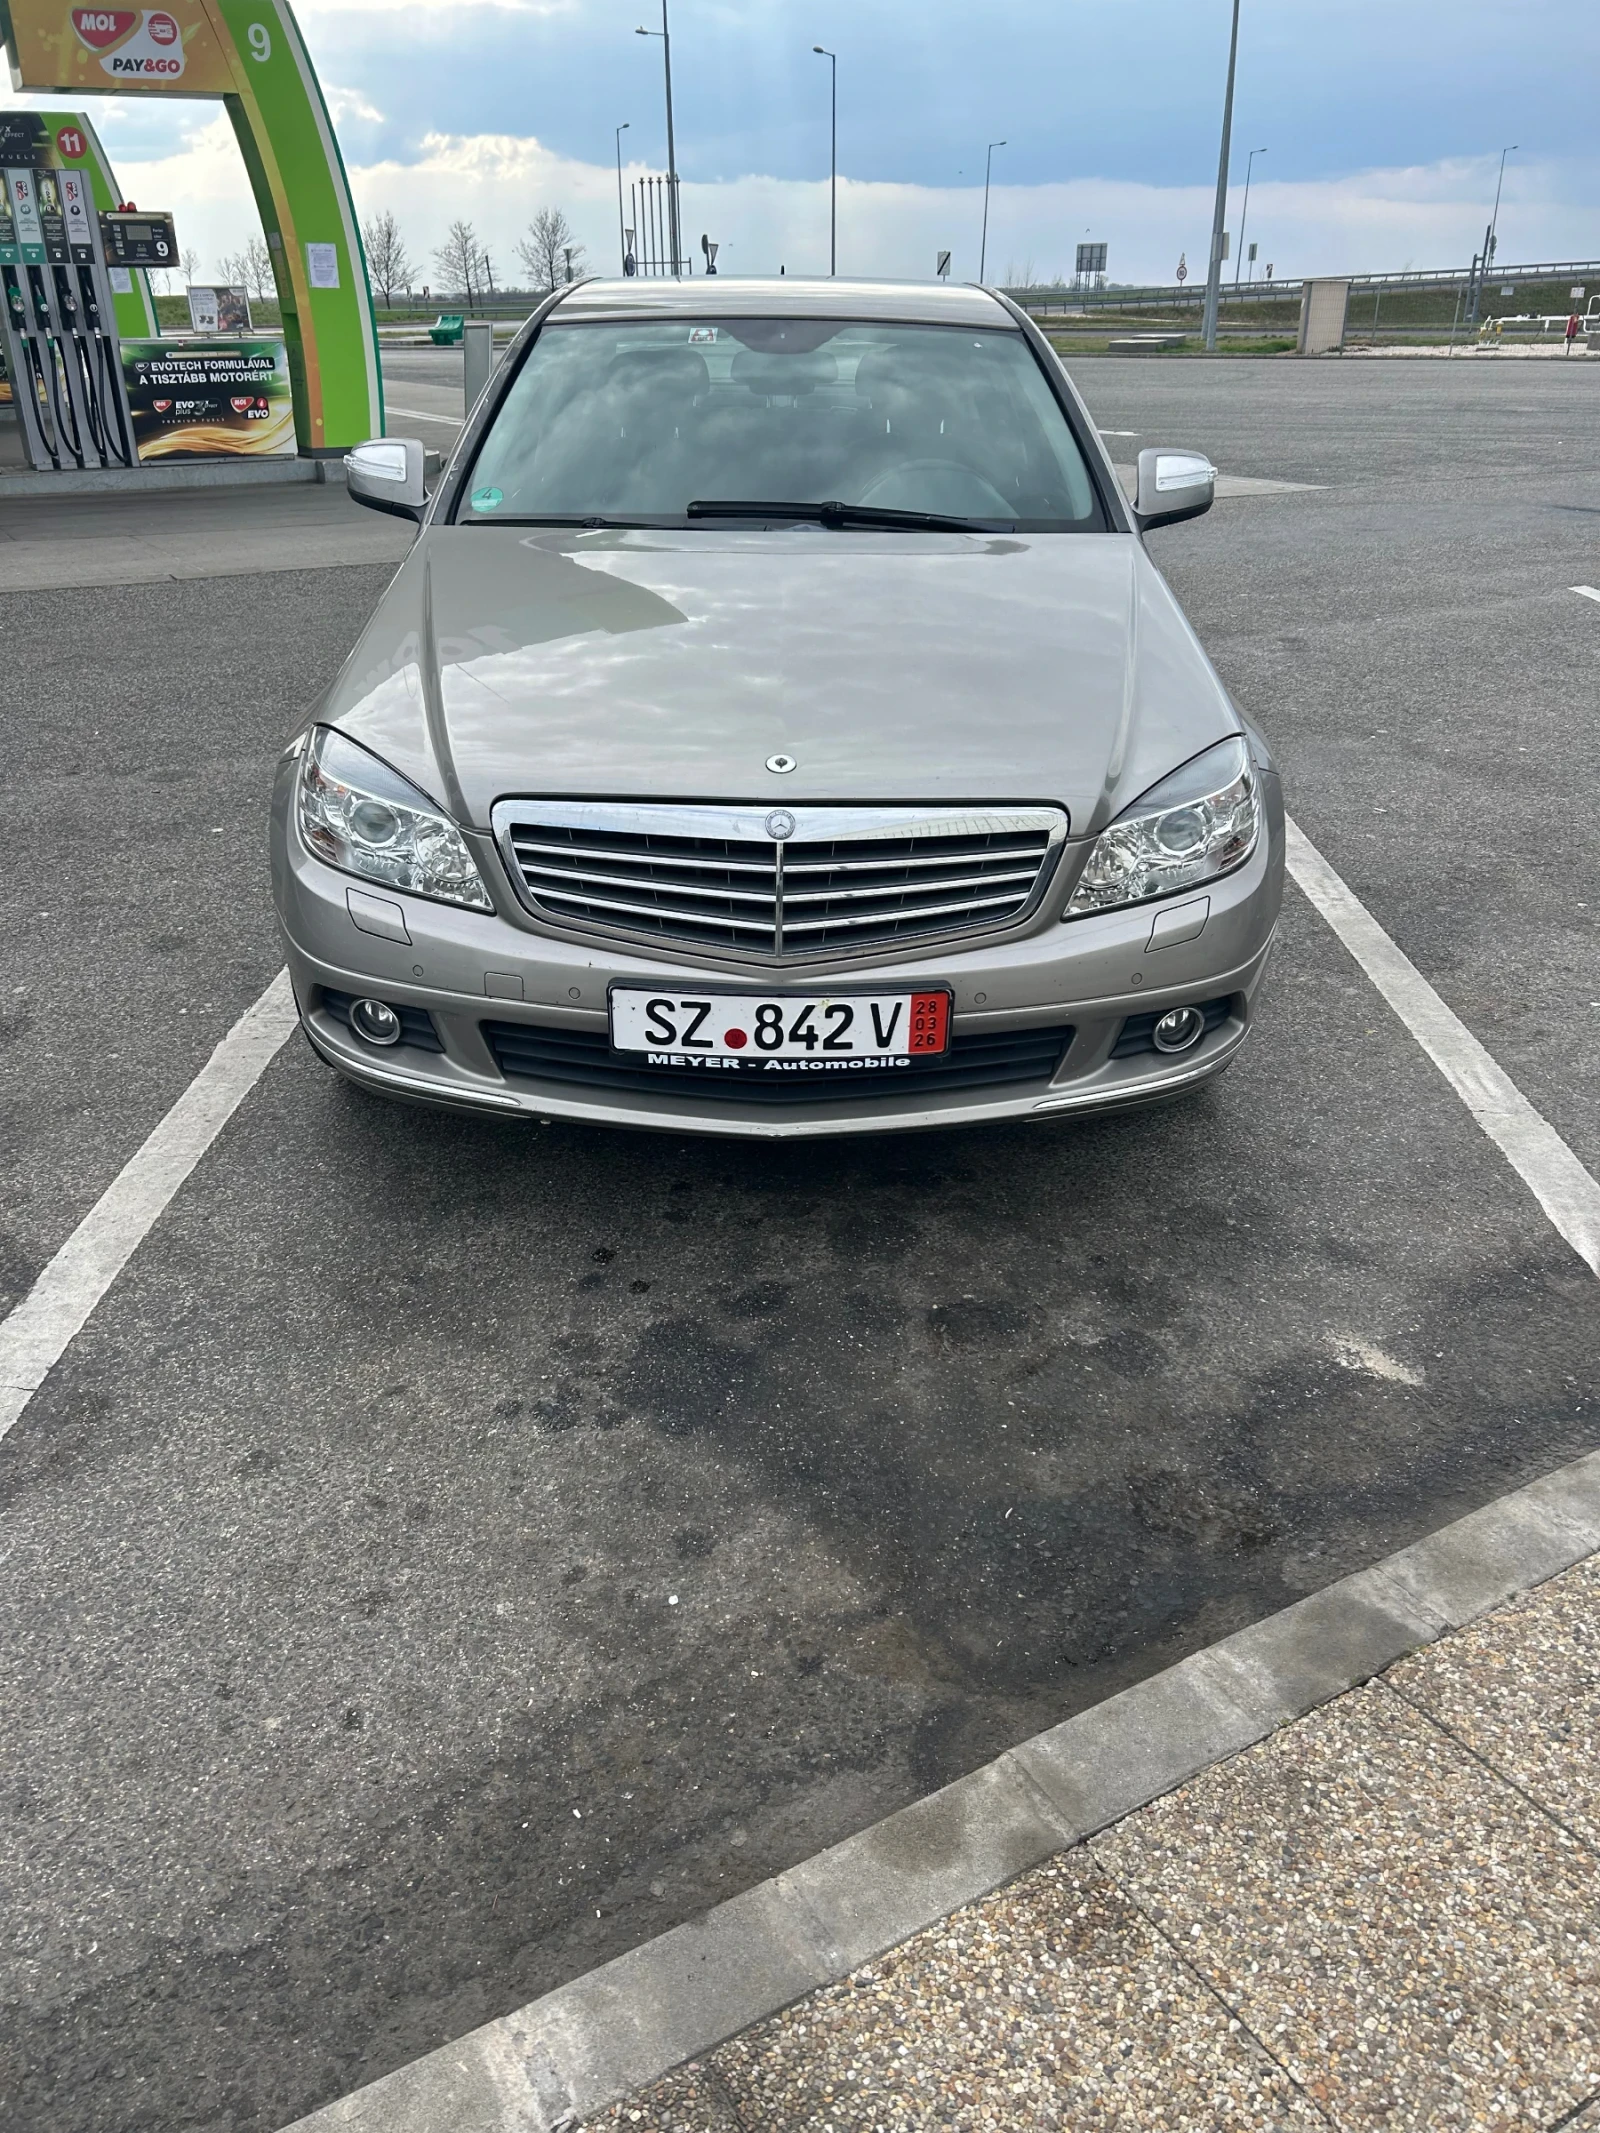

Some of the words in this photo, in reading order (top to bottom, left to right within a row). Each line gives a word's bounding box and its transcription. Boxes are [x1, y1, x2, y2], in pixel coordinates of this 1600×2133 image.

[80, 14, 116, 31] MOL
[247, 23, 271, 62] 9
[112, 58, 180, 73] PAY&GO
[60, 133, 81, 152] 11
[156, 241, 169, 257] 9
[151, 361, 201, 371] EVOTECH
[204, 358, 273, 370] FORMULÁVAL
[139, 375, 148, 385] A
[150, 371, 207, 385] TISZTÁBB
[210, 369, 274, 382] MOTORÉRT
[175, 401, 195, 409] EVO
[175, 408, 191, 416] plus
[247, 410, 268, 418] EVO
[482, 488, 492, 500] 4
[916, 1000, 937, 1014] 28
[645, 998, 713, 1048] SZ
[754, 1003, 854, 1051] 842
[870, 1002, 902, 1049] V
[915, 1016, 936, 1030] 03
[914, 1033, 936, 1047] 26
[648, 1054, 740, 1069] MEYER
[762, 1057, 911, 1071] Automobile
